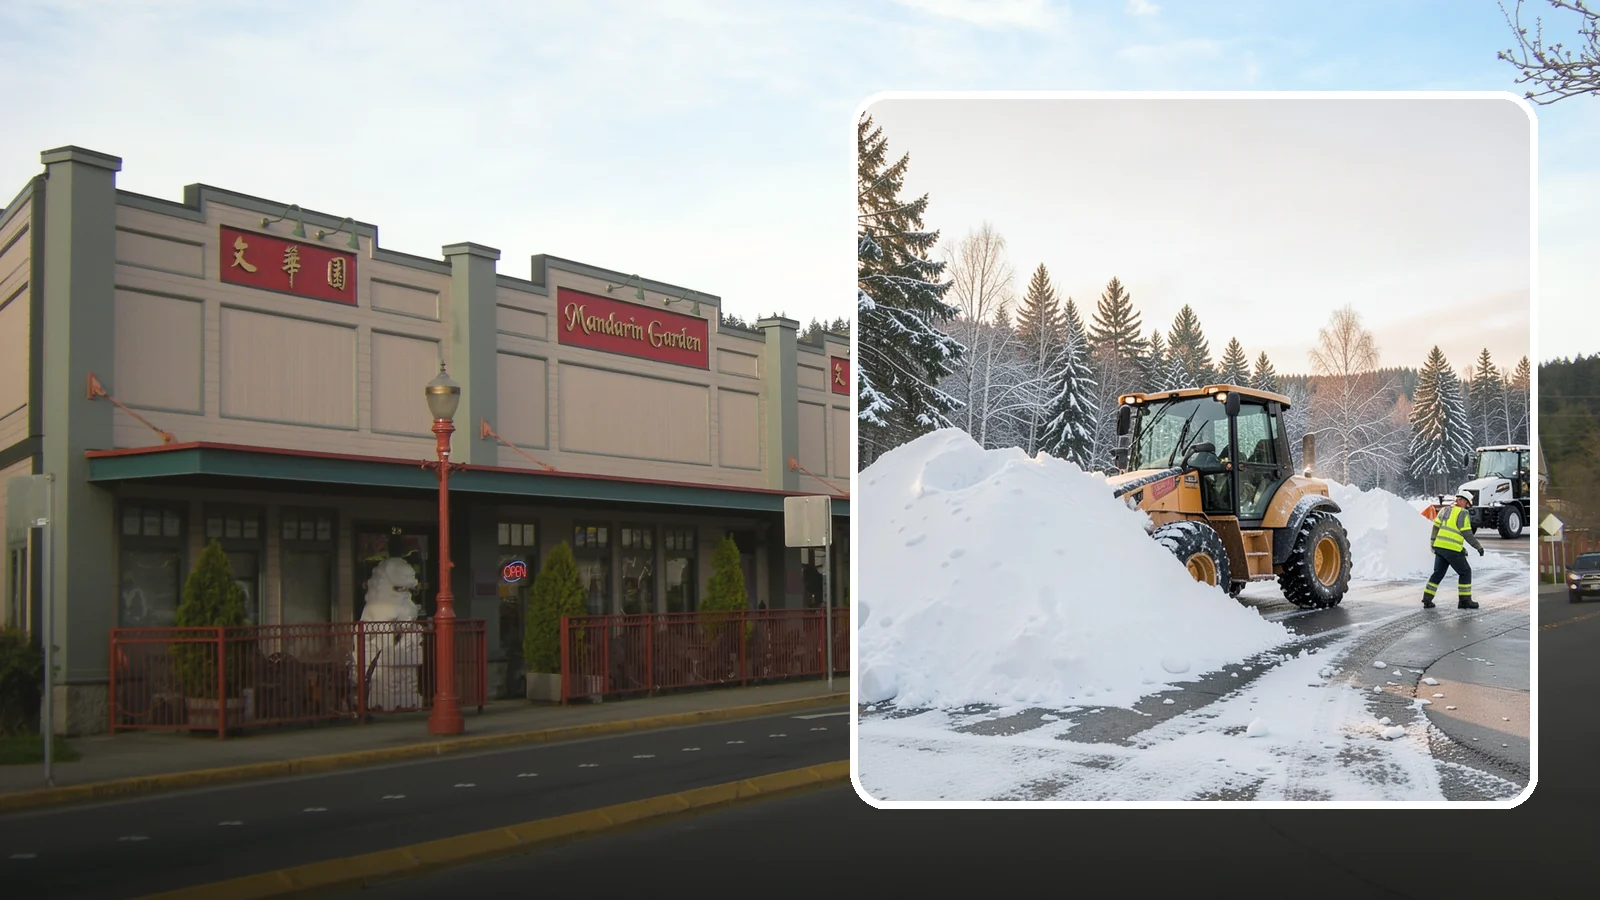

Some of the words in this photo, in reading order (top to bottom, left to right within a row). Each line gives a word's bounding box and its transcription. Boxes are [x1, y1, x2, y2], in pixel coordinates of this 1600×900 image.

[564, 302, 644, 341] Mandarin
[648, 320, 702, 352] Garden
[834, 363, 846, 386] 文
[503, 565, 527, 578] OPEN
